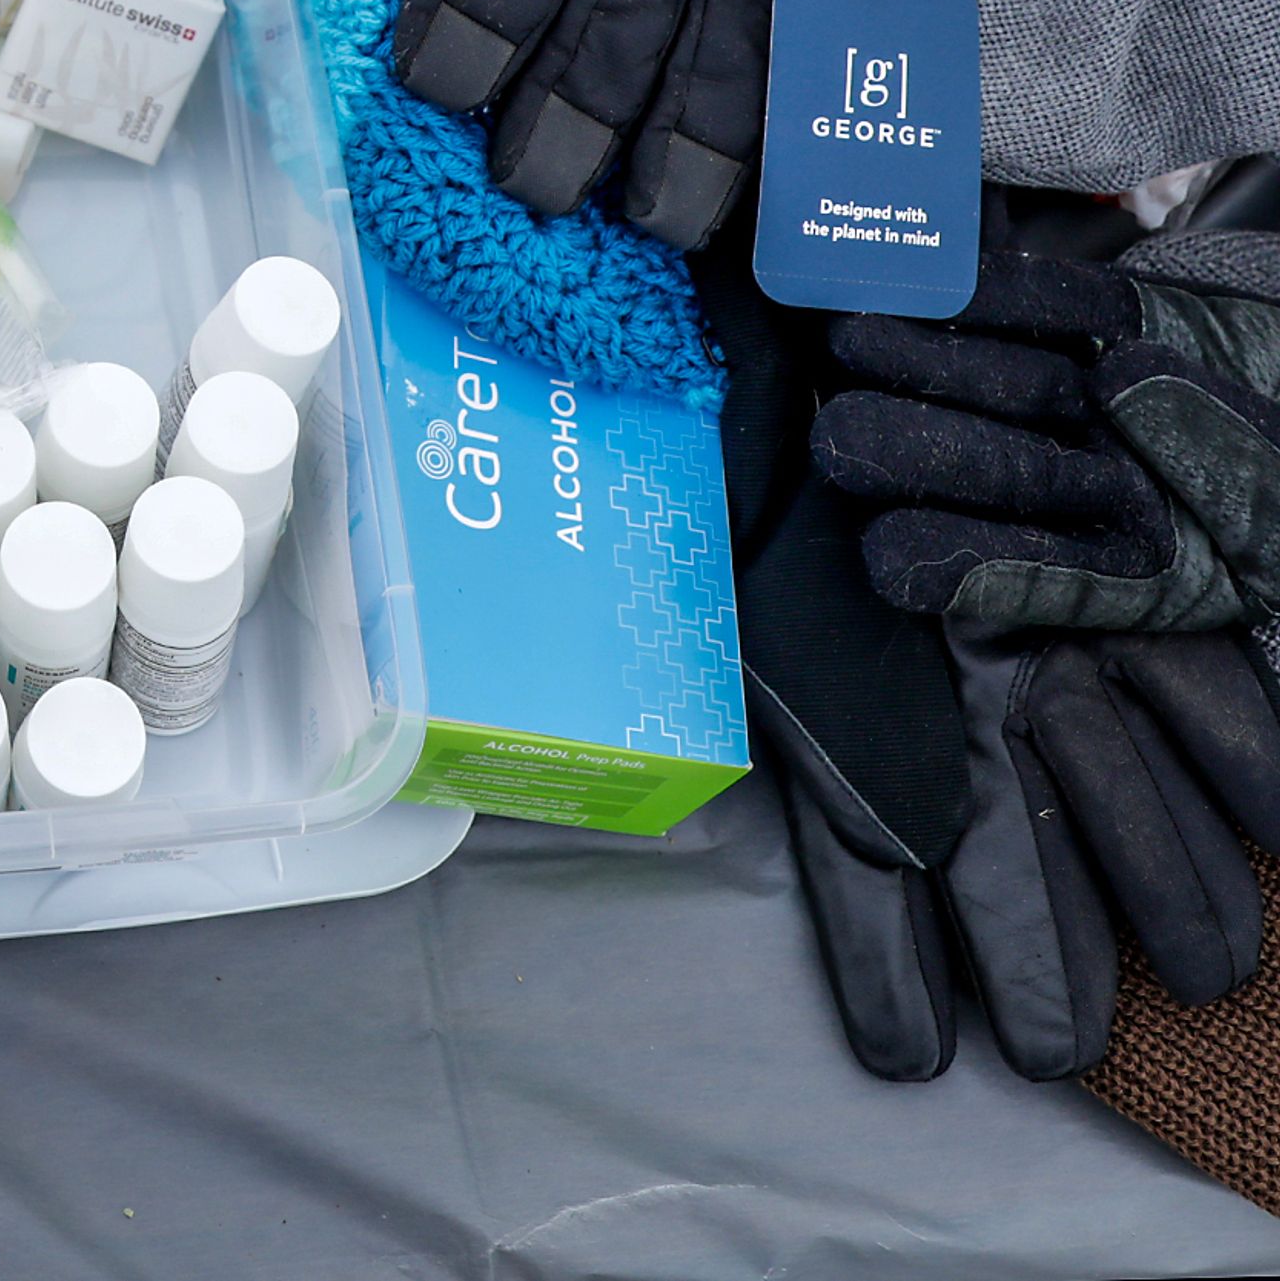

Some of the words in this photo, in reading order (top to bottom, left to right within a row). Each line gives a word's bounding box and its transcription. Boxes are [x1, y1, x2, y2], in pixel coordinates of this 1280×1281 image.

[126, 9, 183, 36] swiss
[820, 199, 892, 222] Designed
[895, 207, 927, 224] with
[803, 221, 828, 238] the
[832, 223, 882, 243] planet
[885, 228, 899, 242] in
[902, 230, 940, 248] mind
[483, 740, 570, 760] ALCOHOL
[576, 752, 609, 765] Prep
[612, 757, 646, 769] Pads
